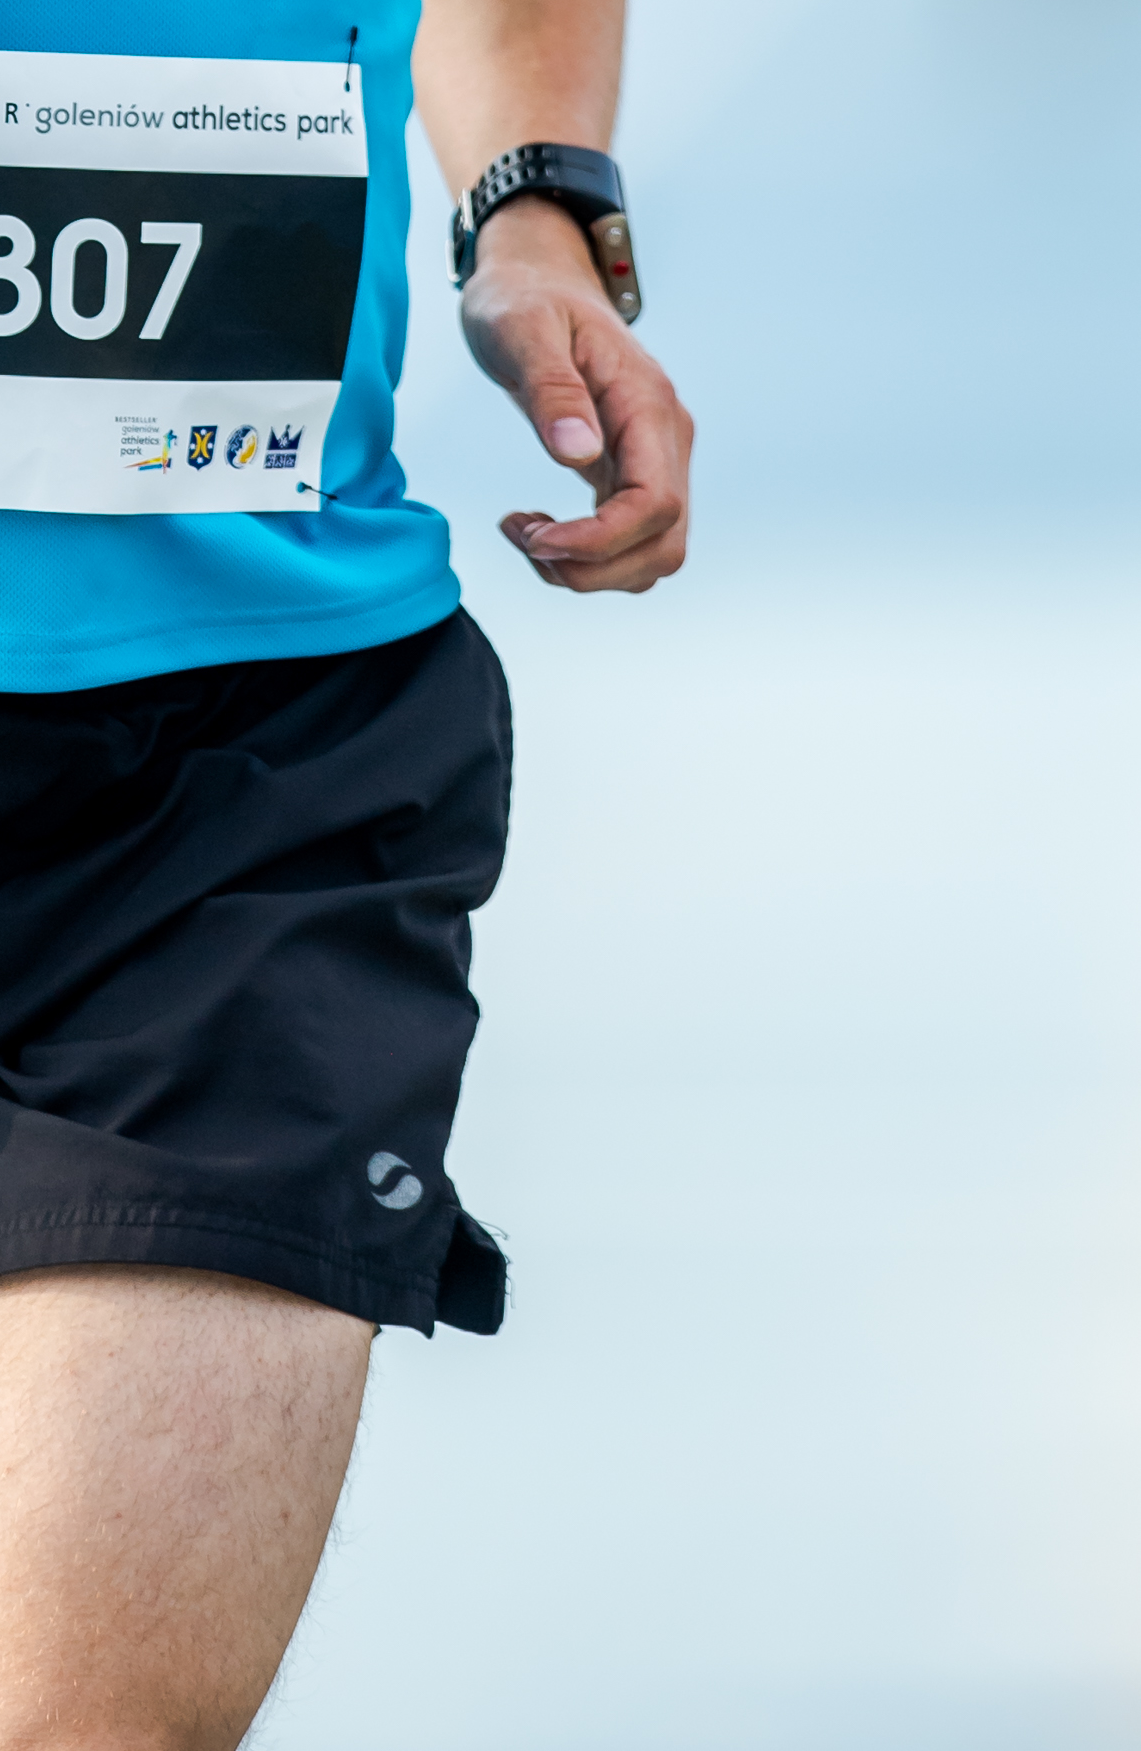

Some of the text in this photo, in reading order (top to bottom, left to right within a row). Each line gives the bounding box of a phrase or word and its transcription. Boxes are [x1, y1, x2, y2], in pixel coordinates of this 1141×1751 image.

[35, 102, 164, 134] goleniów
[172, 104, 287, 132] athletics
[296, 109, 354, 141] park
[114, 415, 157, 424] BESTSELLER
[120, 435, 160, 446] athletics
[119, 446, 143, 458] park
